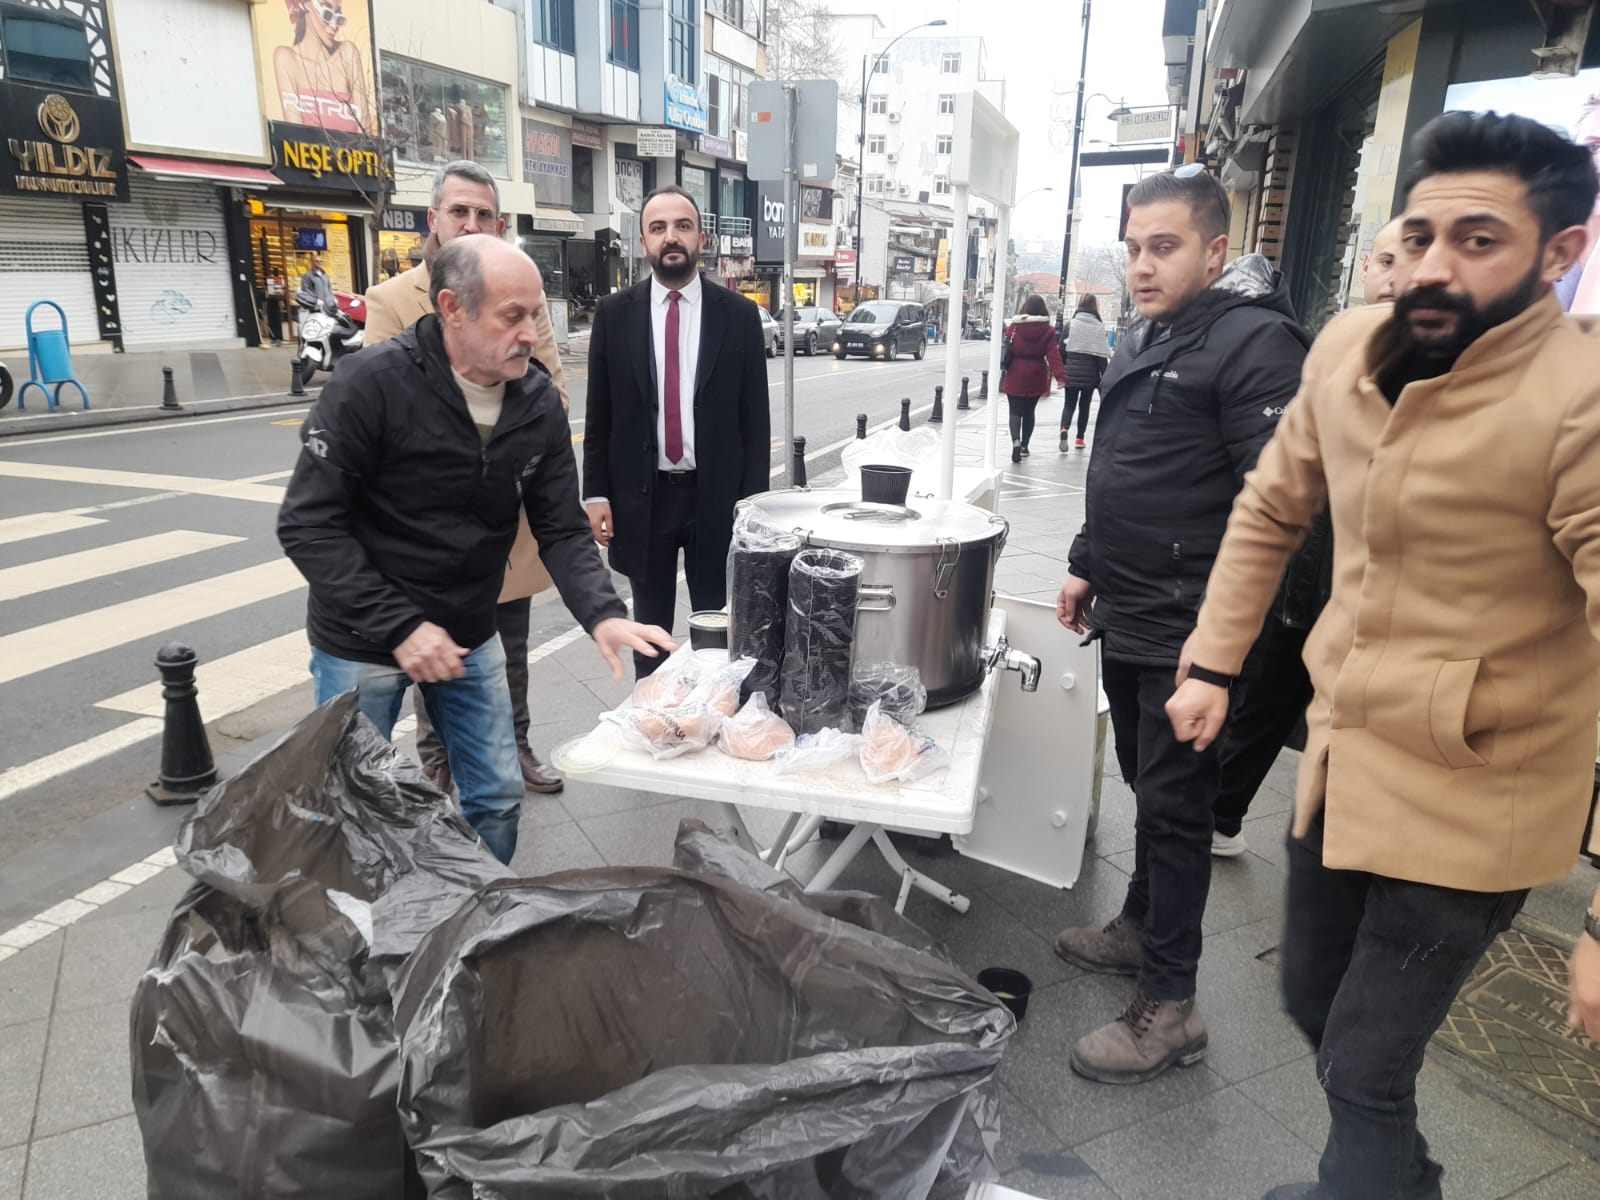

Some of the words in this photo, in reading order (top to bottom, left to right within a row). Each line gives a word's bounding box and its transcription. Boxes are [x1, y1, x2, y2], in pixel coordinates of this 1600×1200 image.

[281, 90, 361, 121] RETRO
[8, 138, 117, 178] YILDIZ
[283, 140, 333, 179] NEŞE
[383, 208, 415, 230] NBB
[768, 226, 784, 239] YATA
